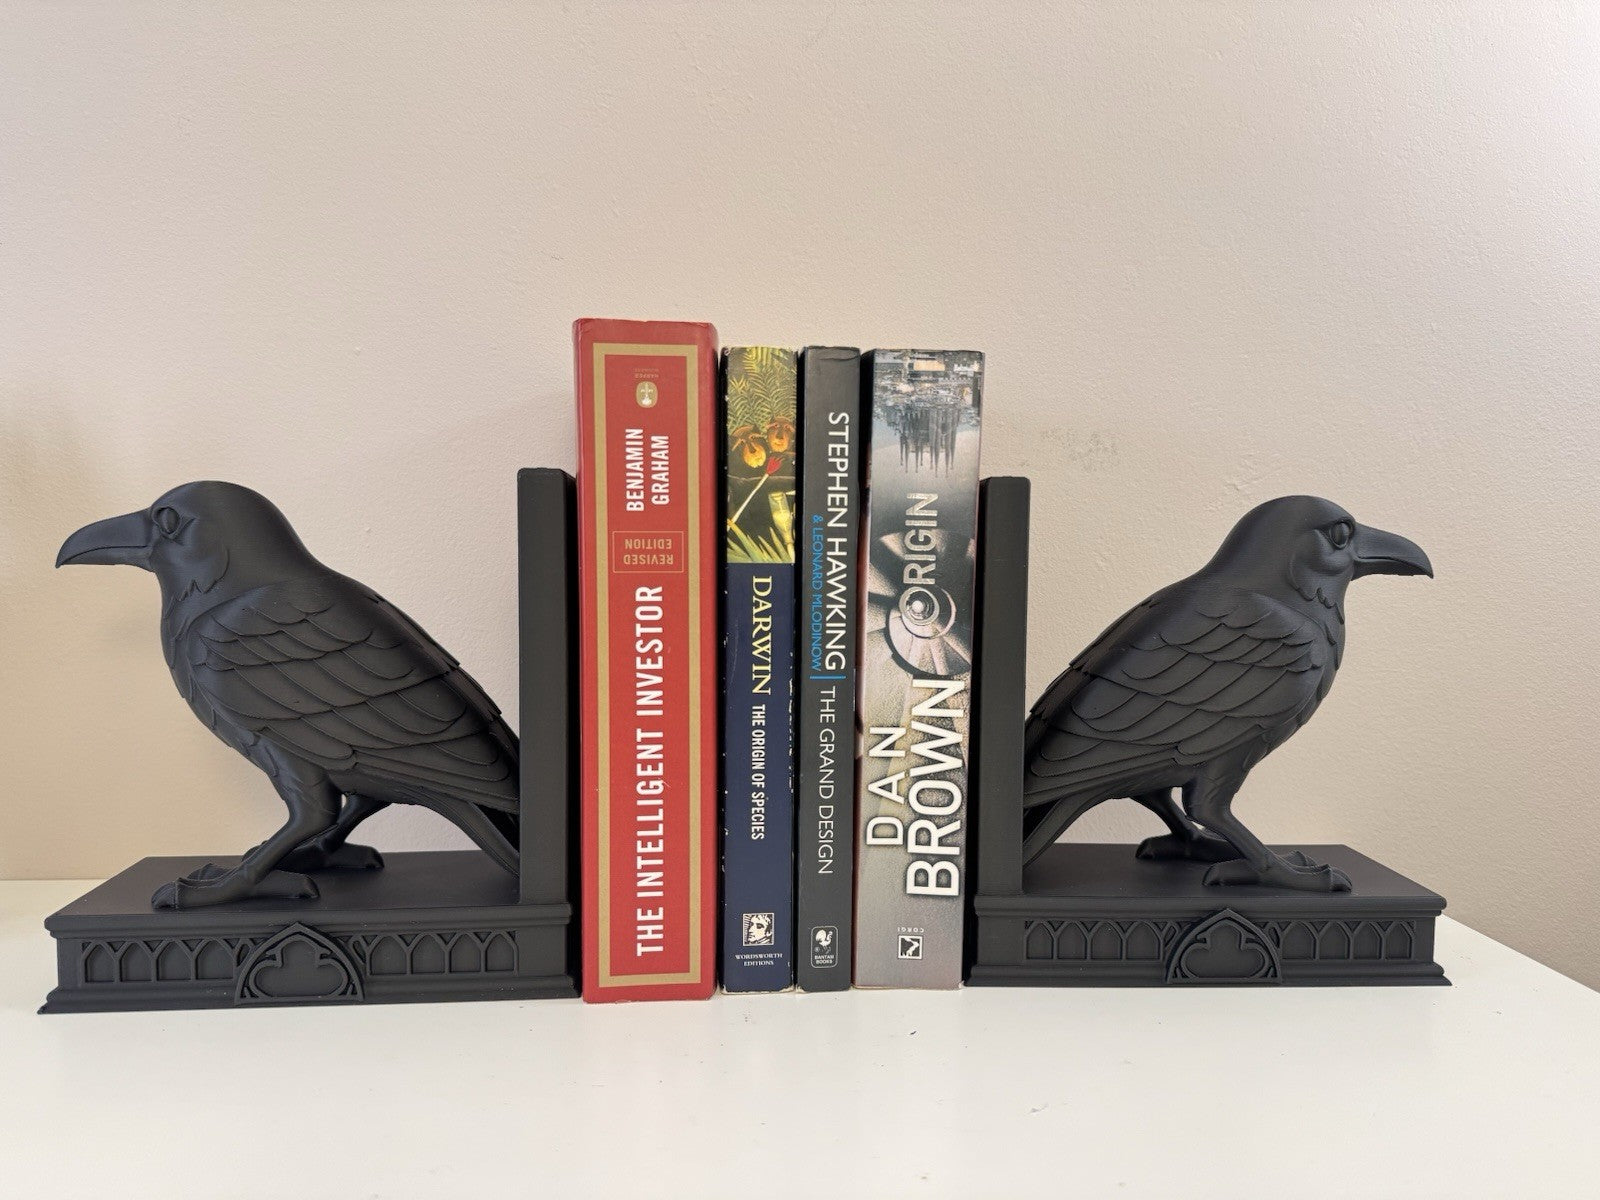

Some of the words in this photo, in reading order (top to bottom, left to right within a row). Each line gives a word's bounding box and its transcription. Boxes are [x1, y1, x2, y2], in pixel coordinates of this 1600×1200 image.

[625, 428, 645, 511] BENJAMIN
[651, 435, 670, 505] GRAHAM
[827, 412, 850, 527] STEPHEN
[624, 538, 673, 550] EDITION
[812, 514, 824, 524] &
[623, 554, 674, 565] REVISED
[811, 527, 824, 590] LEONARD
[899, 492, 939, 626] ORIGIN
[752, 575, 773, 695] DARWIN
[810, 594, 824, 672] MLODINOW
[825, 537, 848, 670] HAWKING
[634, 585, 664, 717] INVESTOR
[751, 703, 766, 727] THE
[819, 686, 836, 724] THE
[751, 729, 766, 771] ORIGIN
[751, 773, 765, 788] OF
[818, 728, 836, 800] GRAND
[635, 727, 664, 898] INTELLIGENT
[750, 791, 765, 841] SPECIES
[866, 726, 907, 846] DAN
[906, 679, 966, 896] BROWN
[817, 804, 835, 874] DESIGN
[636, 906, 664, 957] THE
